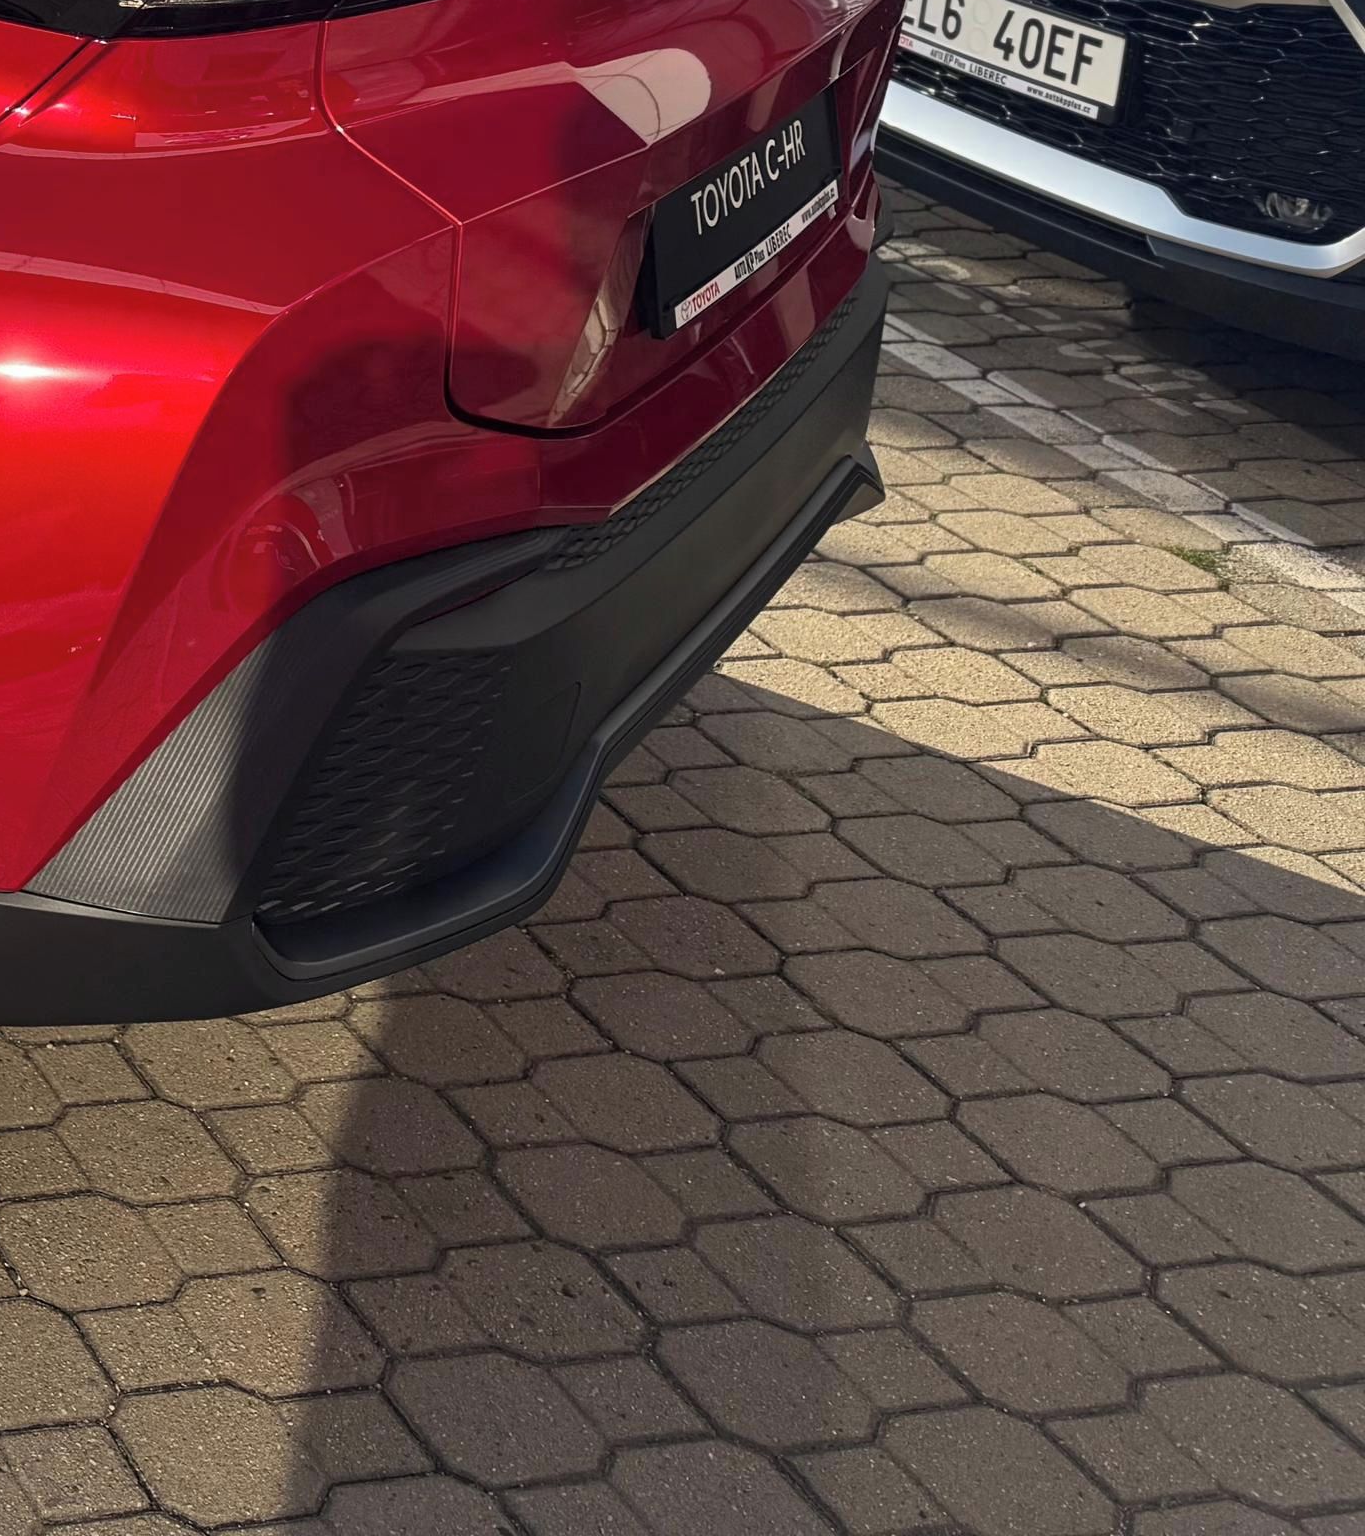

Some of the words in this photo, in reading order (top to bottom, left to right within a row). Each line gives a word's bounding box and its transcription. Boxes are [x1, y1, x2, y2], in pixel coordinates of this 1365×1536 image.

[968, 63, 1008, 86] LIBEREC
[992, 9, 1104, 86] 40EF
[690, 151, 765, 235] TOYOTA
[765, 119, 806, 181] C-HR
[691, 281, 721, 313] TOYOTA
[765, 223, 792, 257] LIBEREC
